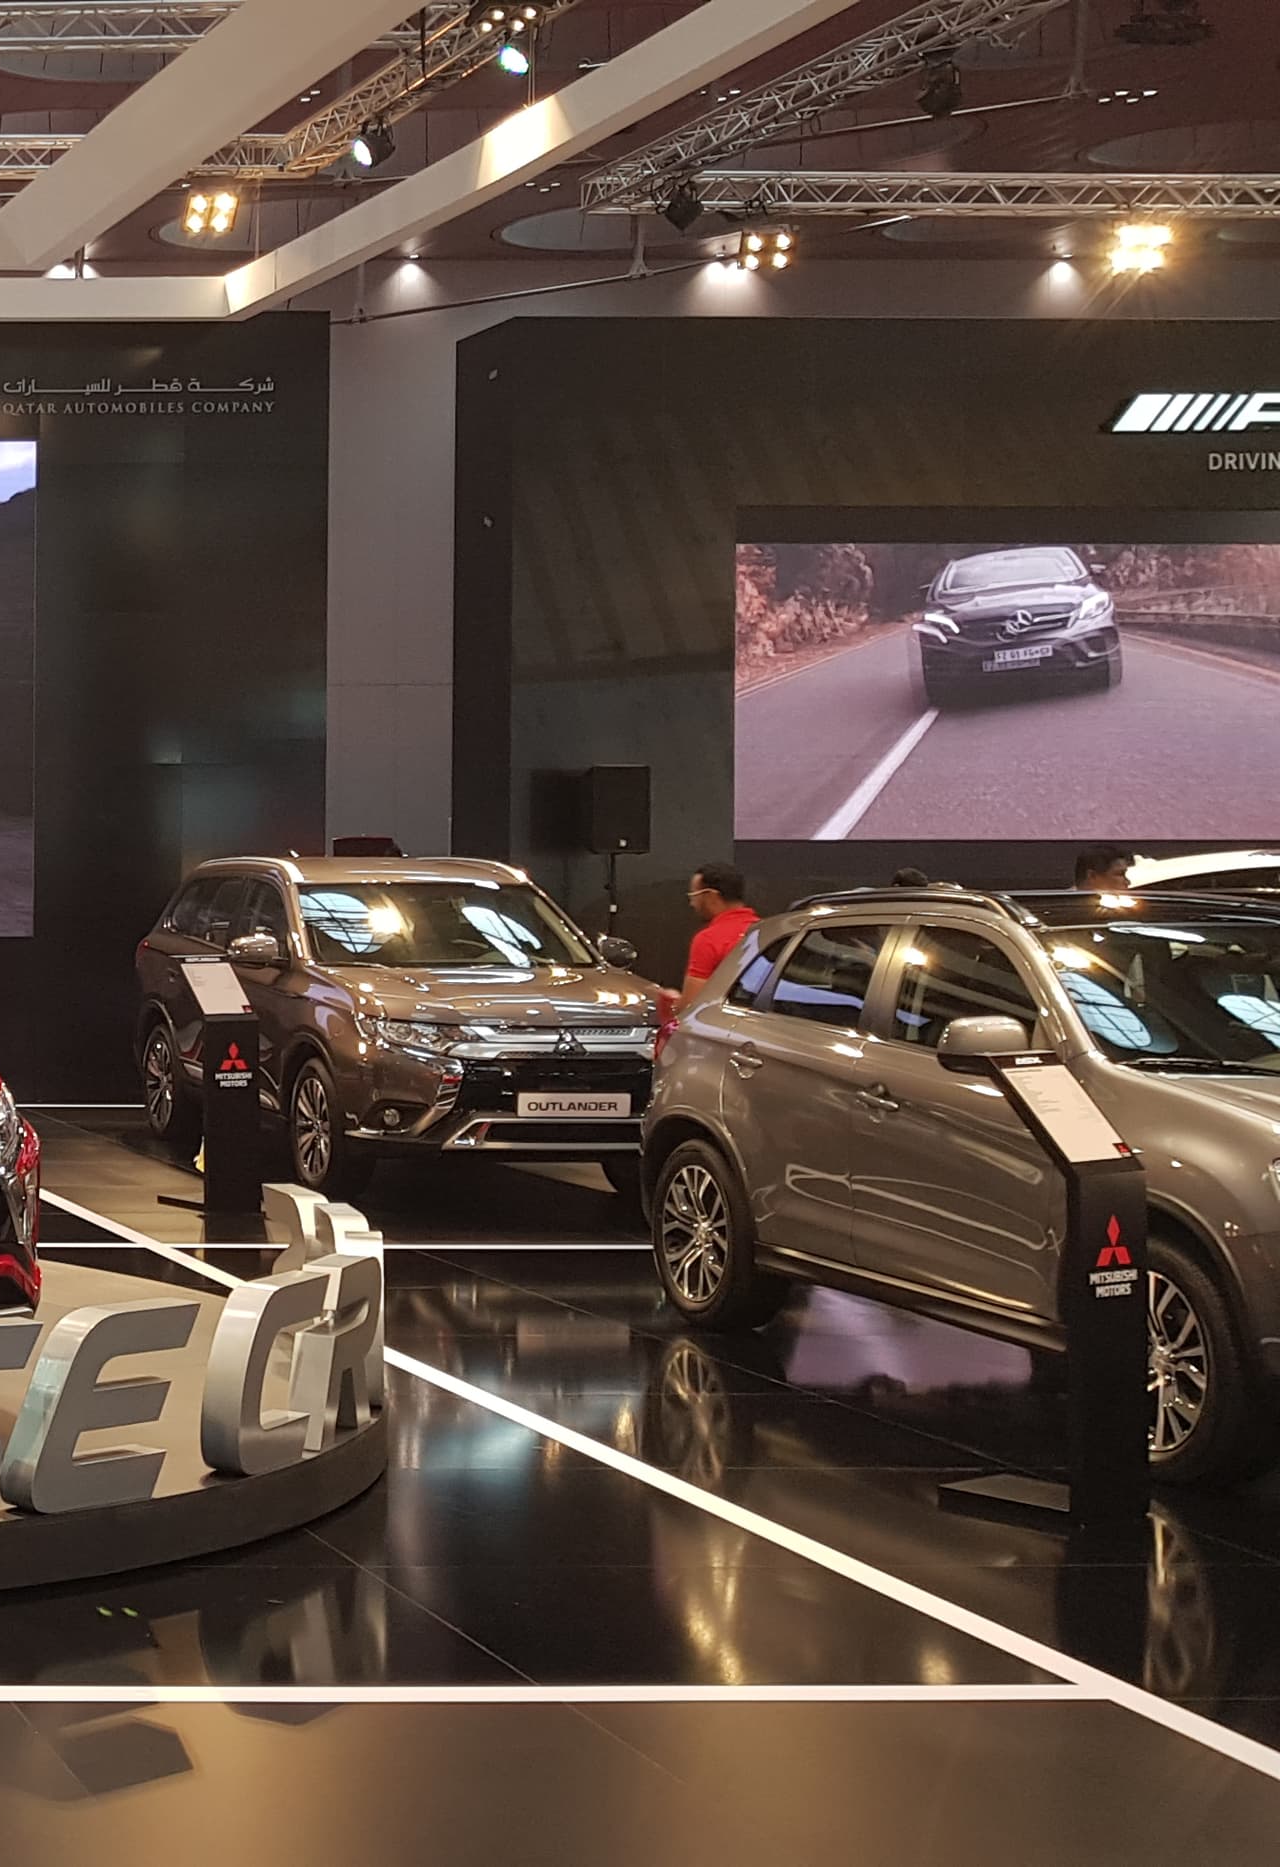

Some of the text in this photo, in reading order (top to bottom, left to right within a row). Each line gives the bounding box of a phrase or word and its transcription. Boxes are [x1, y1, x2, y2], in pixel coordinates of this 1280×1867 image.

[3, 376, 274, 396] شركة قطر للسيارات
[3, 401, 274, 416] QATAR AUTOMOBILES COMPANY
[527, 1102, 619, 1112] OUTLANDER
